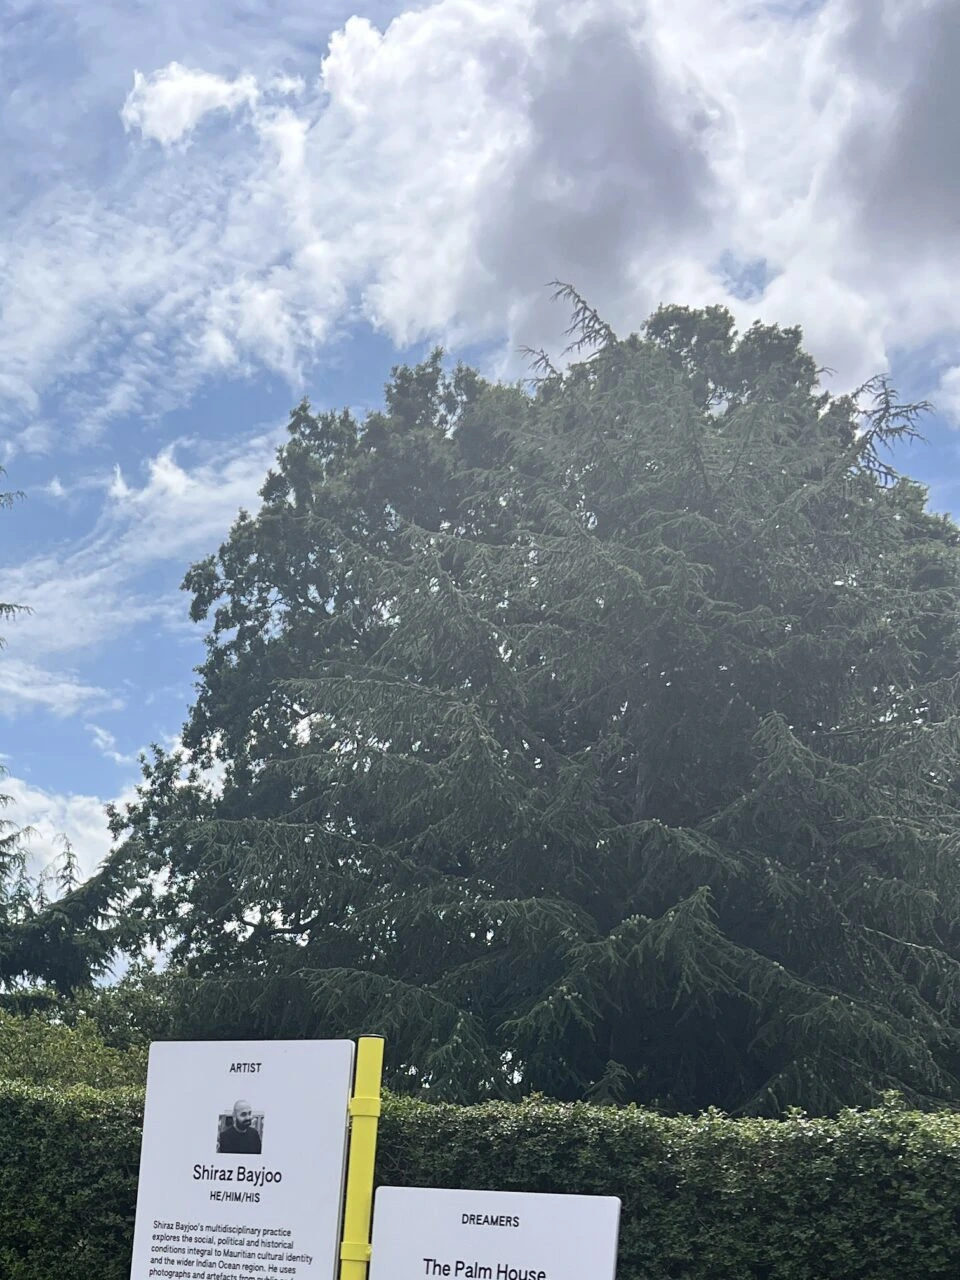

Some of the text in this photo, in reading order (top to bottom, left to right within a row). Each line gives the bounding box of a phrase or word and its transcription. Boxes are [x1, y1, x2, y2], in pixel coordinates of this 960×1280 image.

[230, 1063, 261, 1073] ARTIST
[193, 1164, 282, 1187] Shiraz Bayjoo
[210, 1191, 261, 1203] HE/HIM/HIS
[153, 1220, 174, 1229] Shiraz
[204, 1224, 261, 1237] multidisciplinary
[262, 1228, 291, 1237] practice
[462, 1214, 520, 1227] DREAMERS
[152, 1233, 180, 1243] explores
[181, 1234, 192, 1243] the
[217, 1236, 245, 1246] political
[246, 1238, 259, 1247] and
[260, 1239, 293, 1249] historical
[150, 1244, 312, 1265] conditions integral to Mauritian cultural identity
[148, 1267, 191, 1279] photographs
[191, 1271, 205, 1279] and
[149, 1256, 163, 1264] and
[163, 1256, 175, 1265] the
[176, 1258, 195, 1266] wider
[195, 1258, 216, 1268] Indian
[217, 1260, 240, 1269] Ocean
[267, 1263, 278, 1273] He
[279, 1266, 296, 1274] uses
[423, 1258, 450, 1276] The
[455, 1260, 492, 1279] Palm
